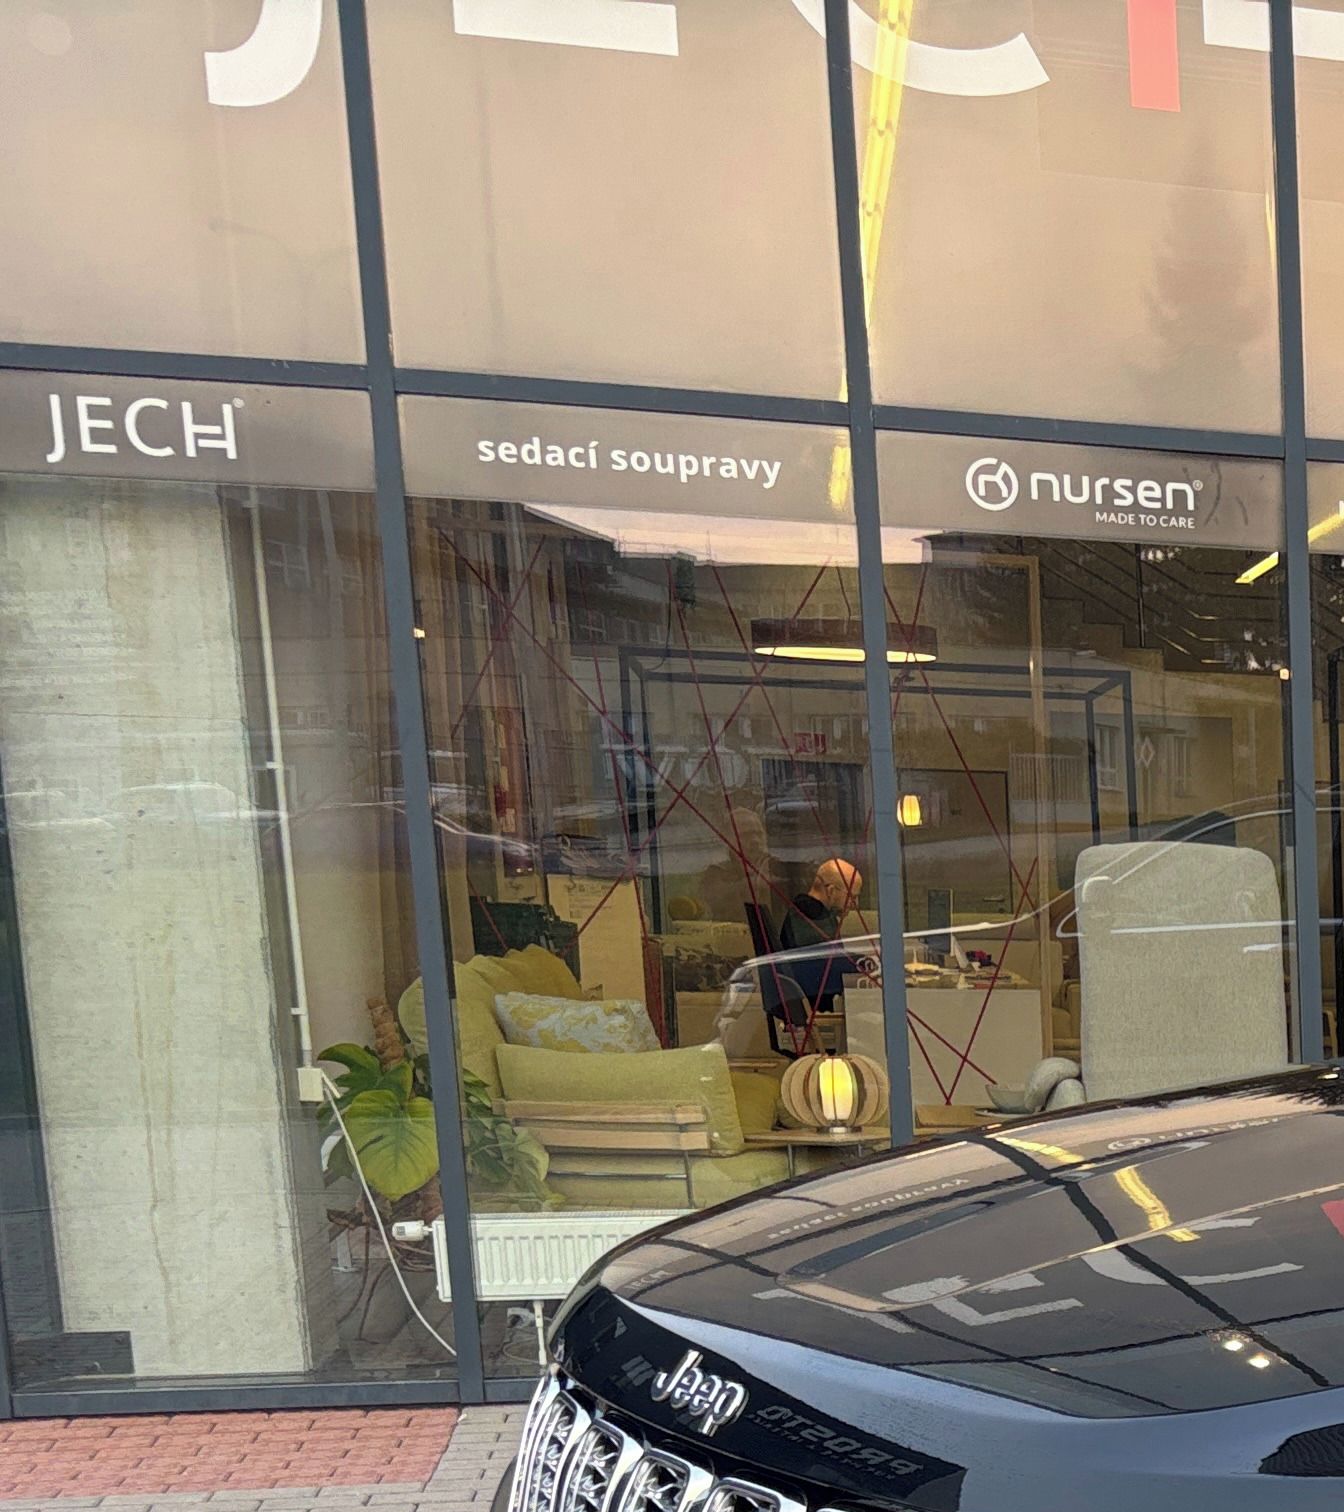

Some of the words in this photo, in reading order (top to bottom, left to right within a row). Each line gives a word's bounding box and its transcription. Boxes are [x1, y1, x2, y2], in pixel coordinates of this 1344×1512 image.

[477, 435, 599, 470] sedací
[609, 448, 783, 489] soupravy
[1030, 472, 1196, 511] nursen
[1095, 511, 1136, 525] MADE
[1138, 513, 1158, 527] TO
[1159, 515, 1195, 529] CARE
[650, 1349, 750, 1438] Jeep
